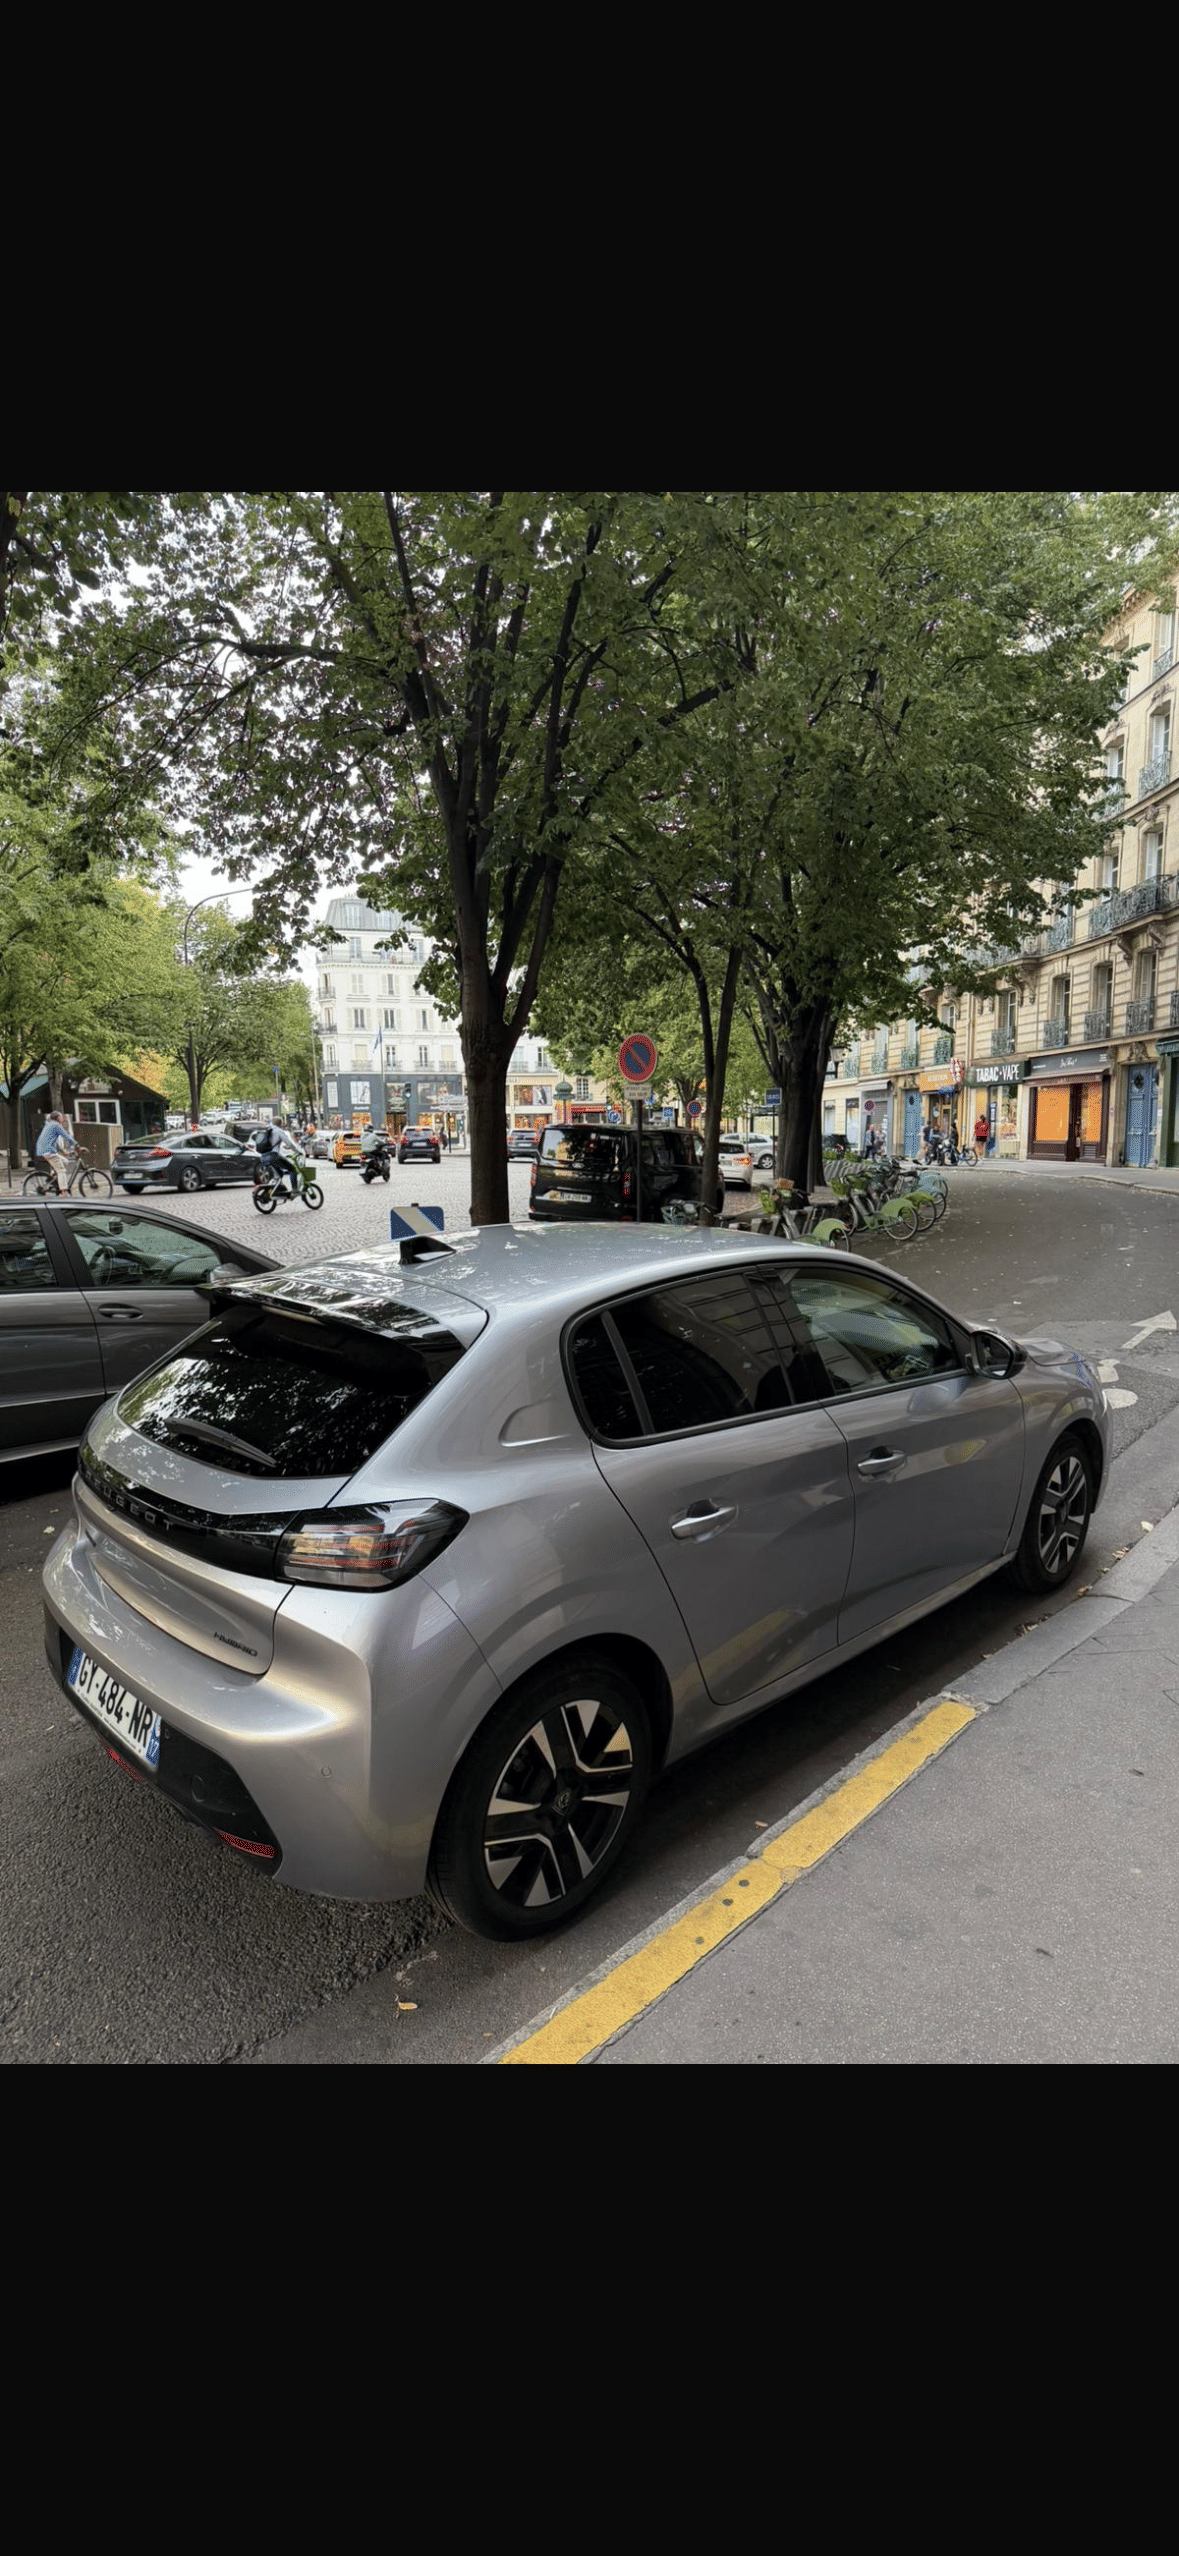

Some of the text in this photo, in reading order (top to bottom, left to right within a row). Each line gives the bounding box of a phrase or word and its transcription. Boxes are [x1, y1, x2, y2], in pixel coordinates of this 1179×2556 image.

[85, 1471, 174, 1531] PEUGEOT
[213, 1631, 258, 1657] HYBRID
[79, 1655, 153, 1749] GY-484-NR
